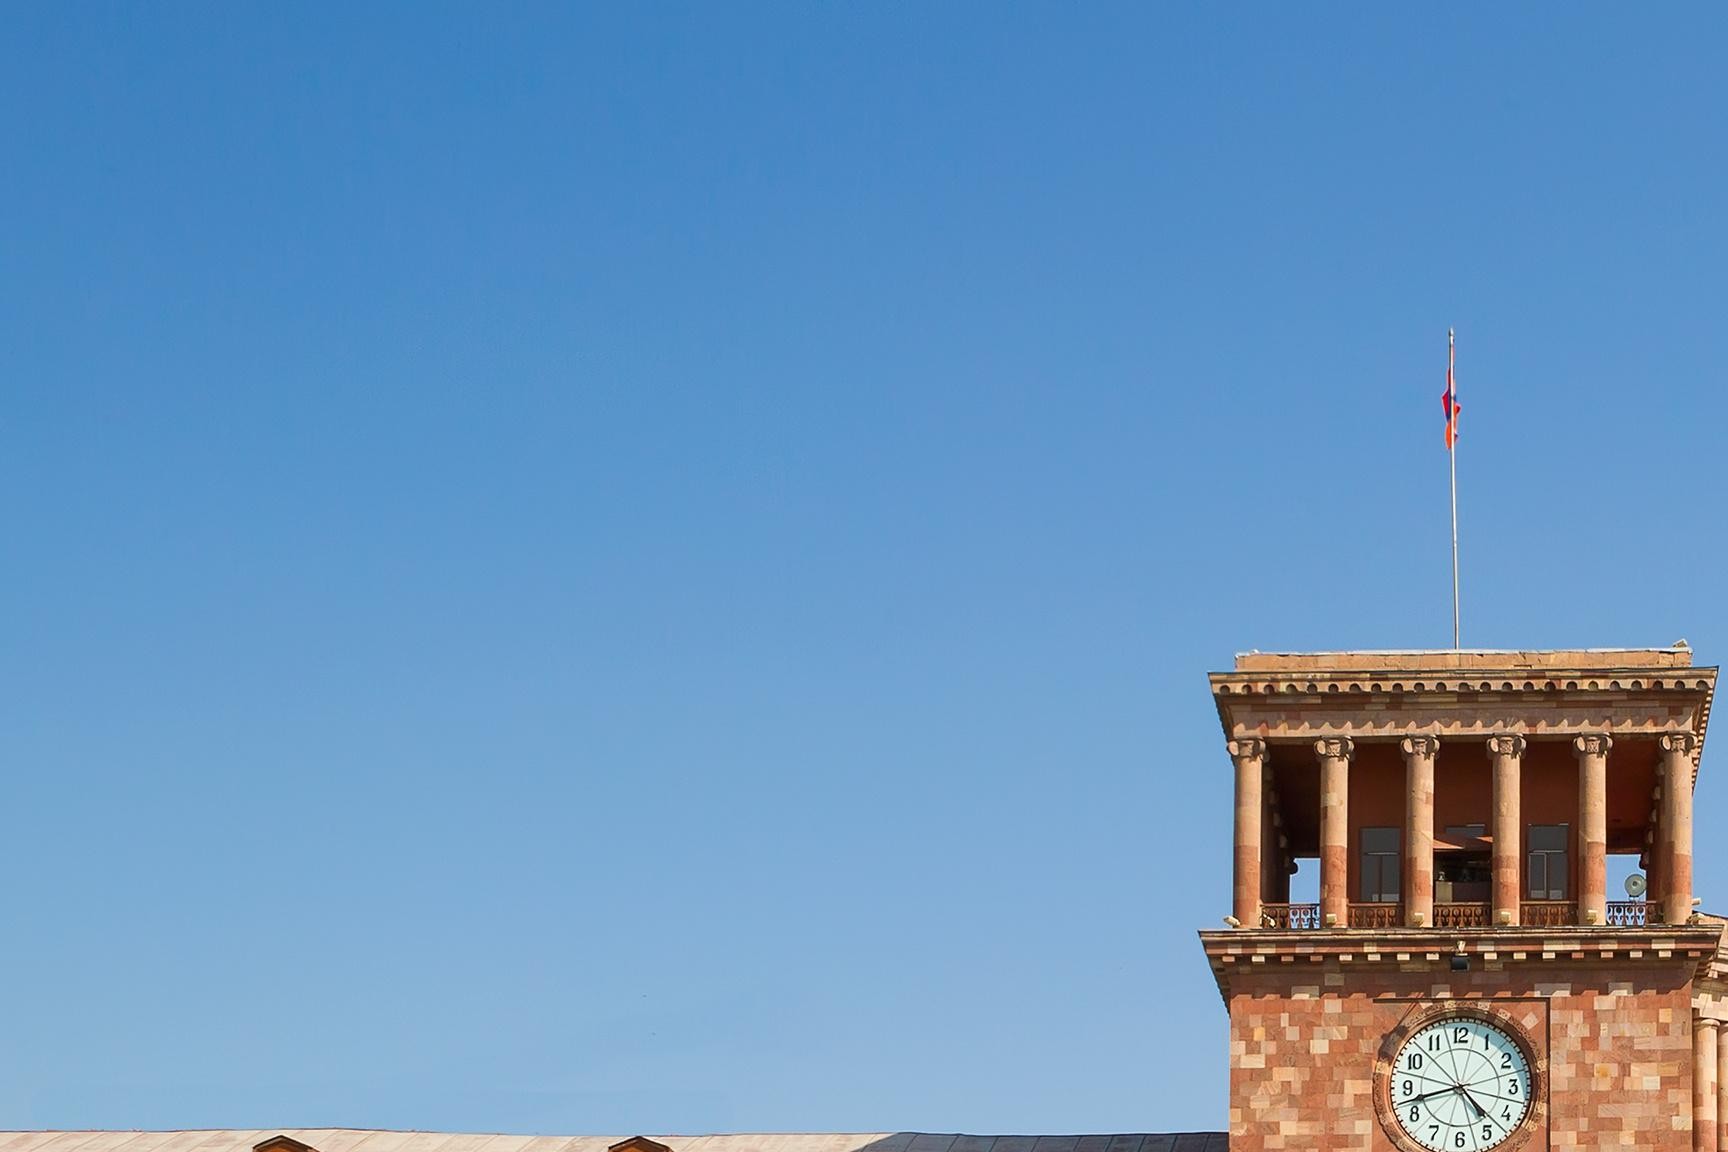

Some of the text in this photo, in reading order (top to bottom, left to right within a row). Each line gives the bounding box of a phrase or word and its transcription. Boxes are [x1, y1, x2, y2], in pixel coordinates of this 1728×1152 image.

[1428, 1034, 1440, 1051] 11
[1453, 1027, 1469, 1044] 12
[1484, 1033, 1490, 1051] 1
[1407, 1053, 1423, 1070] 10
[1501, 1052, 1512, 1069] 2
[1402, 1080, 1413, 1096] 9
[1508, 1079, 1518, 1095] 3
[1409, 1105, 1420, 1122] 8
[1501, 1104, 1511, 1121] 4
[1428, 1125, 1439, 1141] 7
[1455, 1131, 1465, 1148] 6
[1481, 1124, 1492, 1141] 5
